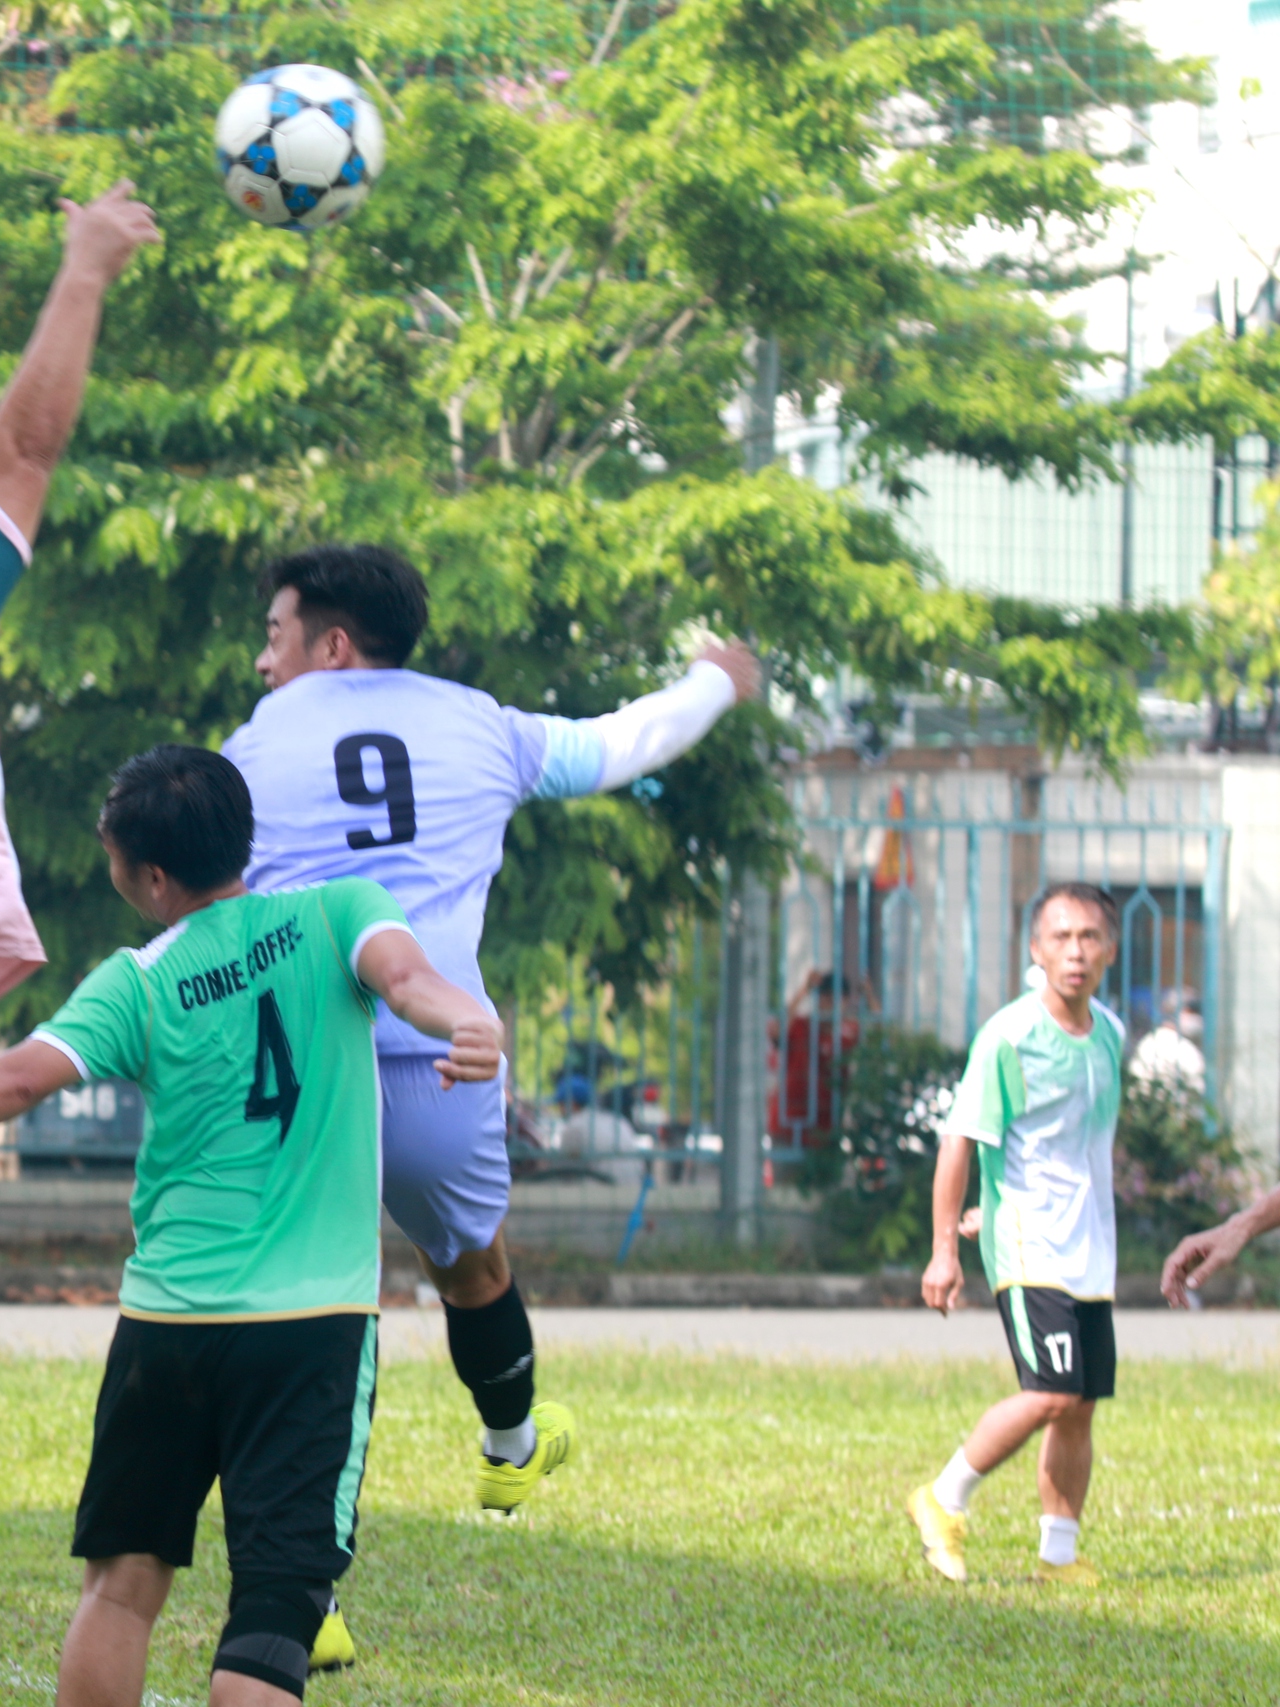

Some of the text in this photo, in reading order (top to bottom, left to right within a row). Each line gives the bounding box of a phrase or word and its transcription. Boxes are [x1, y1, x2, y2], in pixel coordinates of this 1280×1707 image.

[334, 732, 417, 850] 9
[244, 986, 302, 1149] 4
[1043, 1331, 1073, 1375] 17
